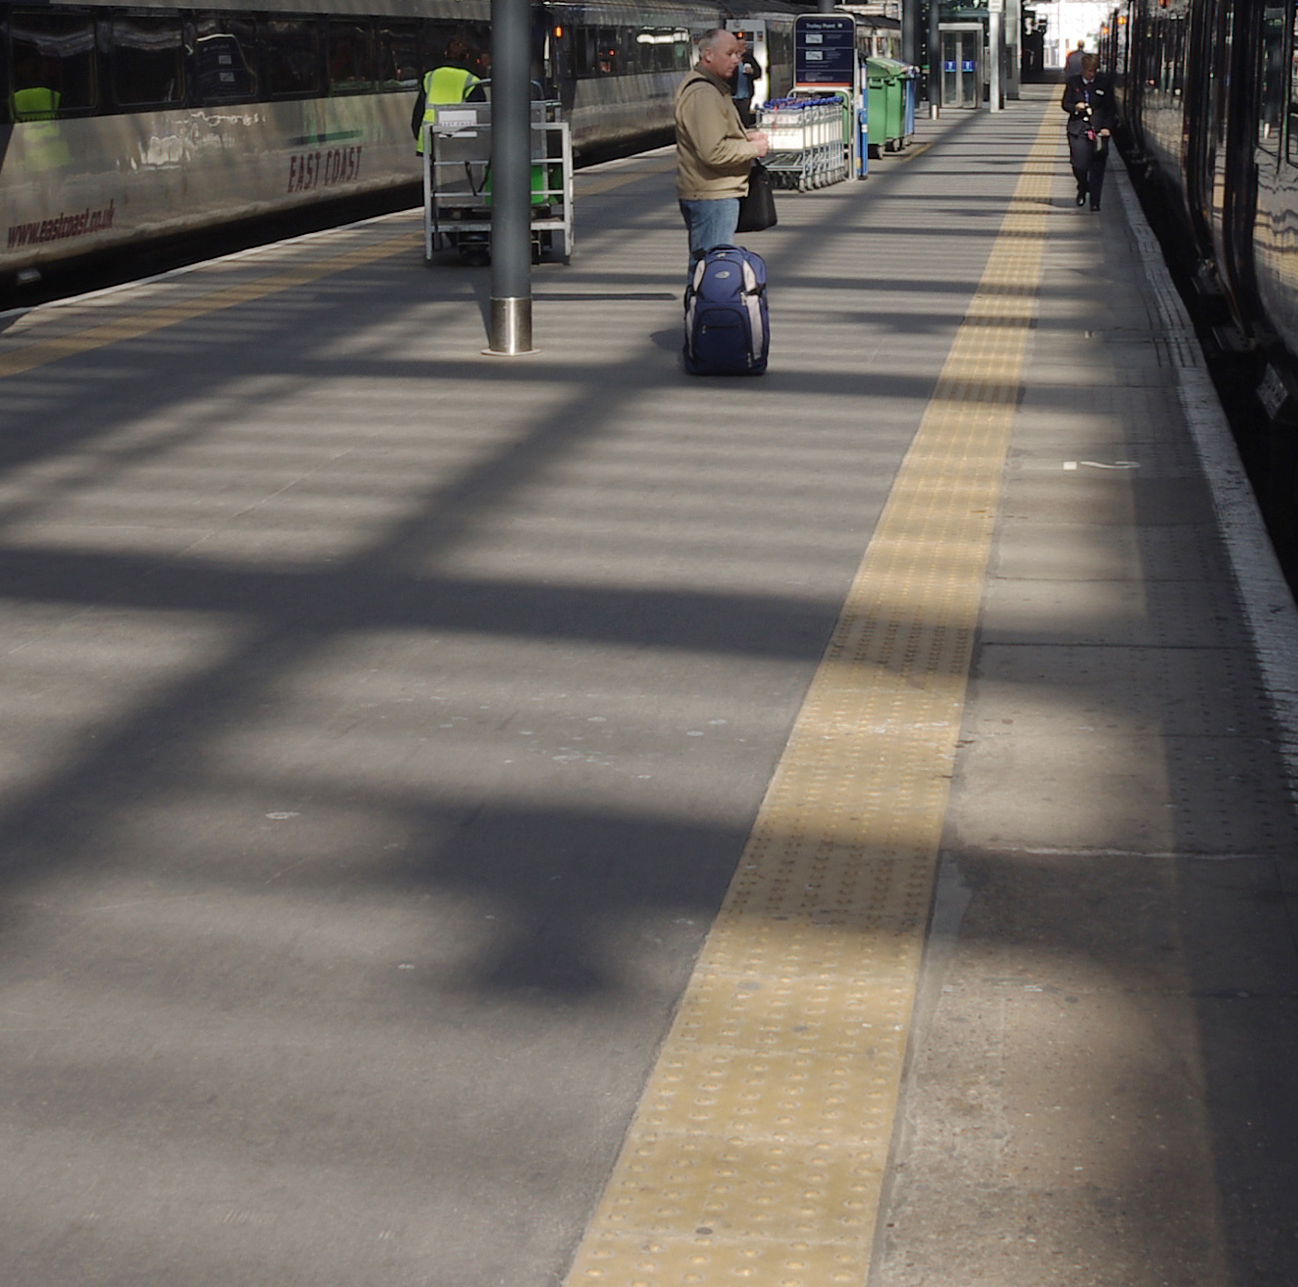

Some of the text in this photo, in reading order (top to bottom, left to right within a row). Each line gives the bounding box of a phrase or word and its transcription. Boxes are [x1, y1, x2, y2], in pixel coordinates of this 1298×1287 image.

[287, 145, 363, 193] EAST COAST
[6, 198, 115, 248] www.eastcoast.co.uk
